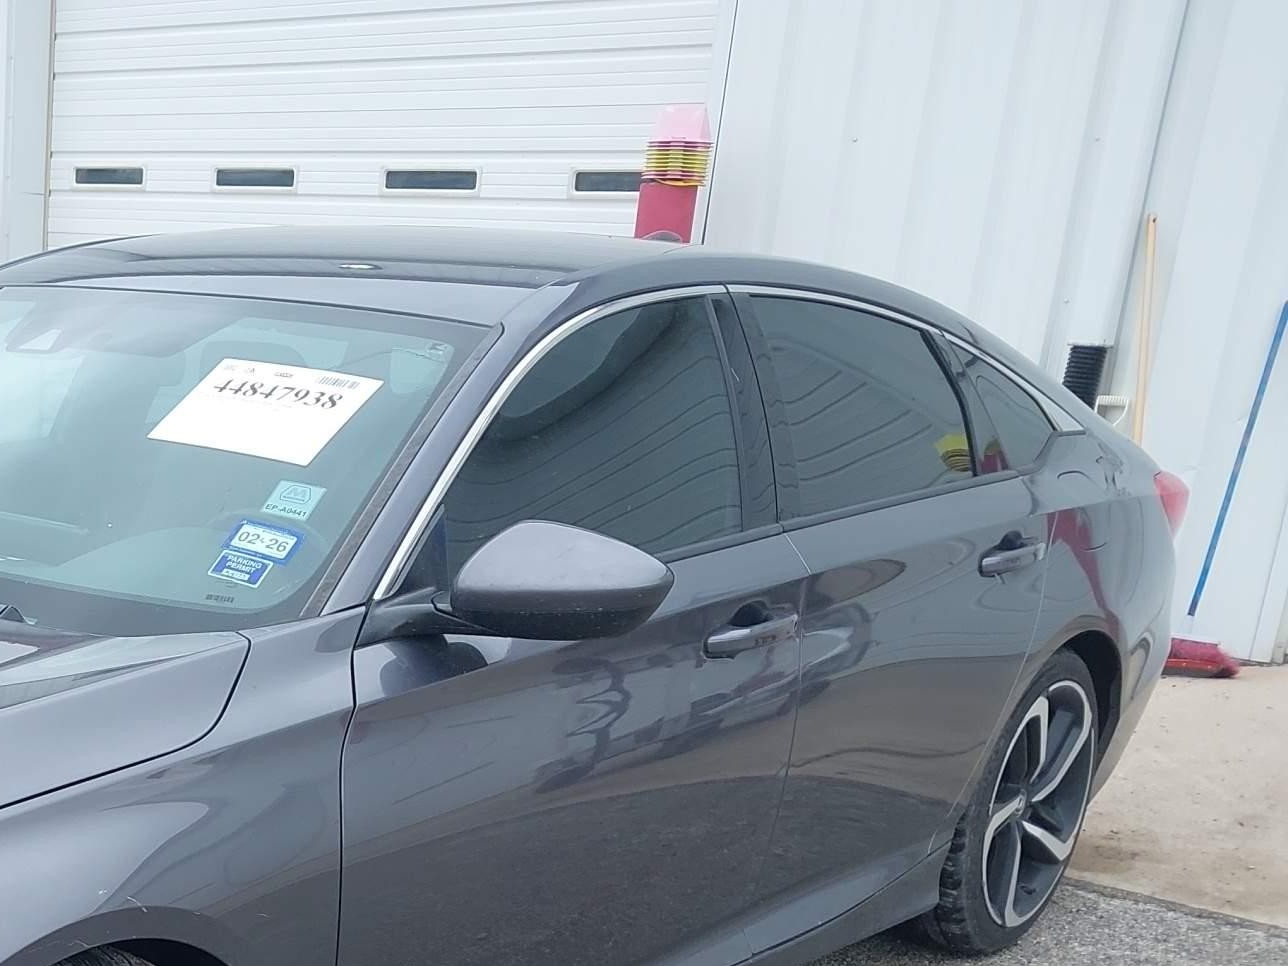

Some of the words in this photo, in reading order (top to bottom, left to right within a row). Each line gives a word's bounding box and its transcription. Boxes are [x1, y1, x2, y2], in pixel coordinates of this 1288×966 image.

[213, 379, 344, 409] 44847938
[226, 561, 256, 573] PERMIT
[227, 555, 263, 569] PARKING
